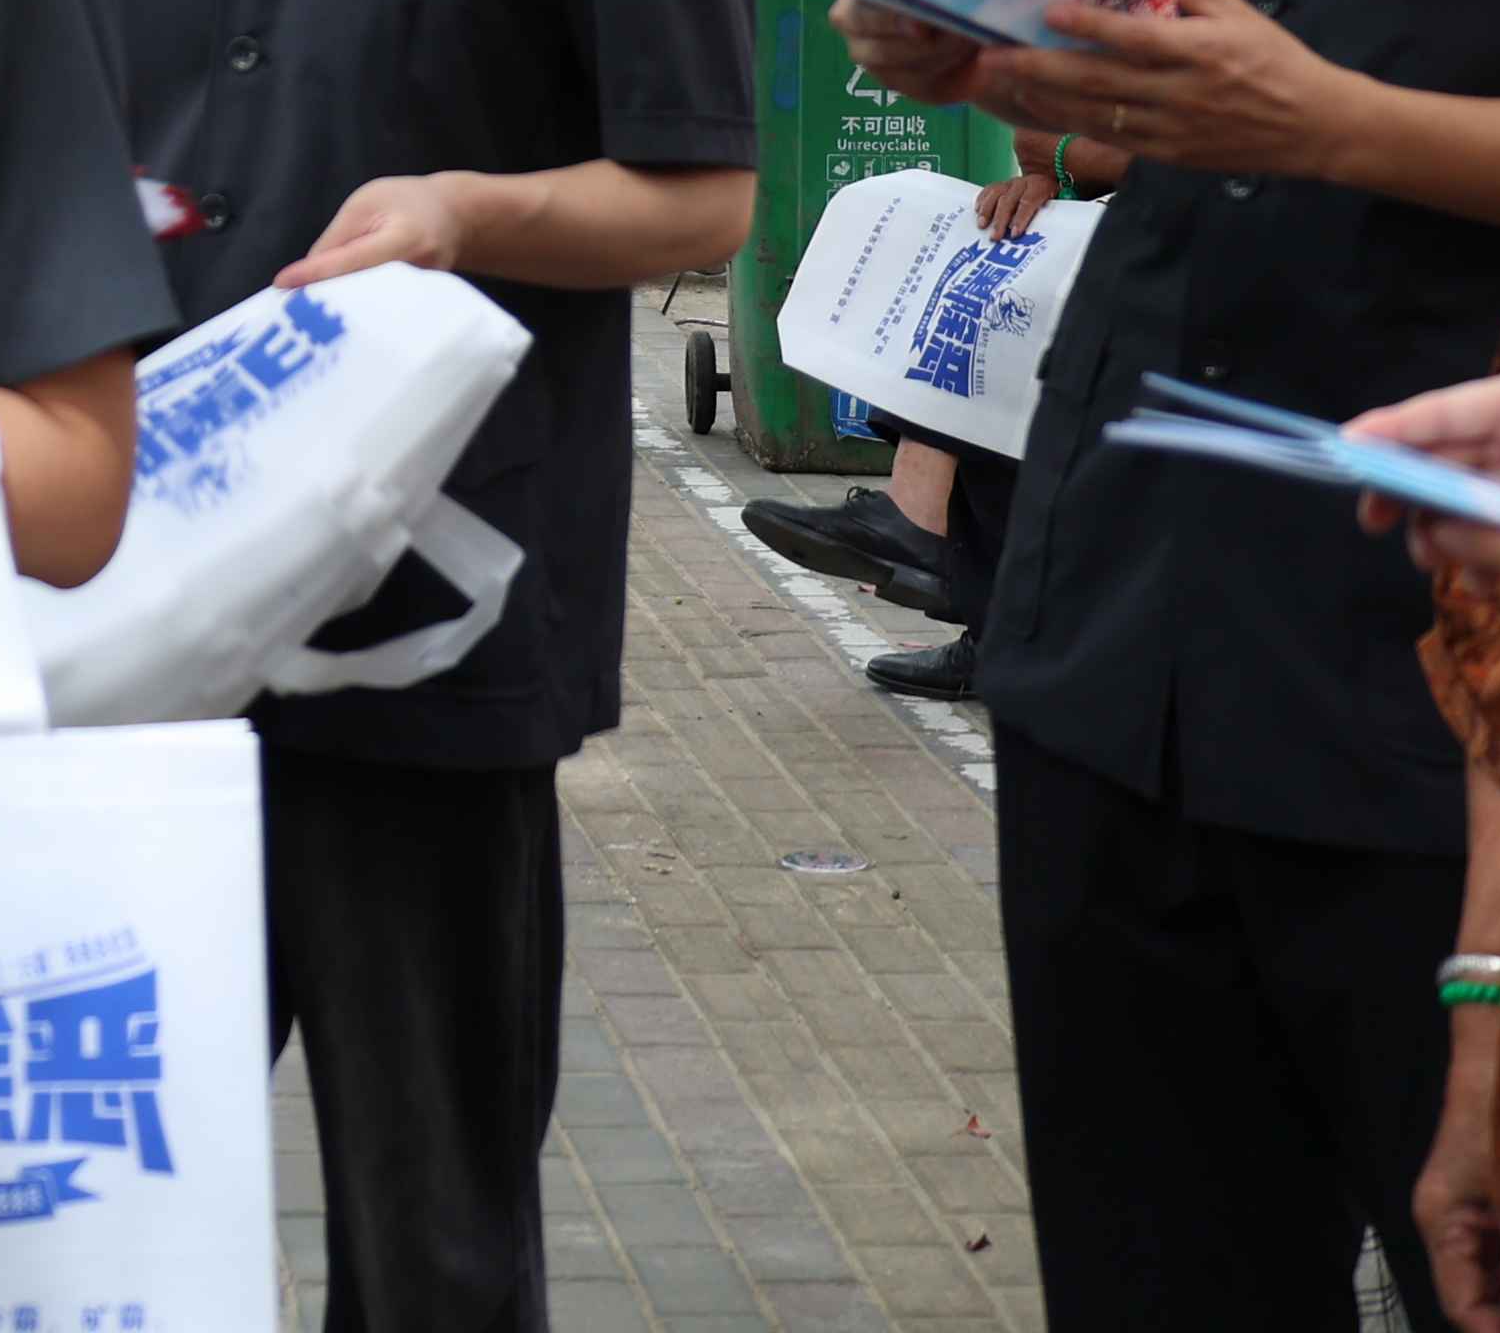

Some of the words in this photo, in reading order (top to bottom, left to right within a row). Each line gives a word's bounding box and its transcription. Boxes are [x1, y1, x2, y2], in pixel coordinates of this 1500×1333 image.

[841, 115, 926, 136] 不可回收
[837, 138, 930, 152] Unrecyclable
[904, 230, 1047, 399] 扫黑除恶
